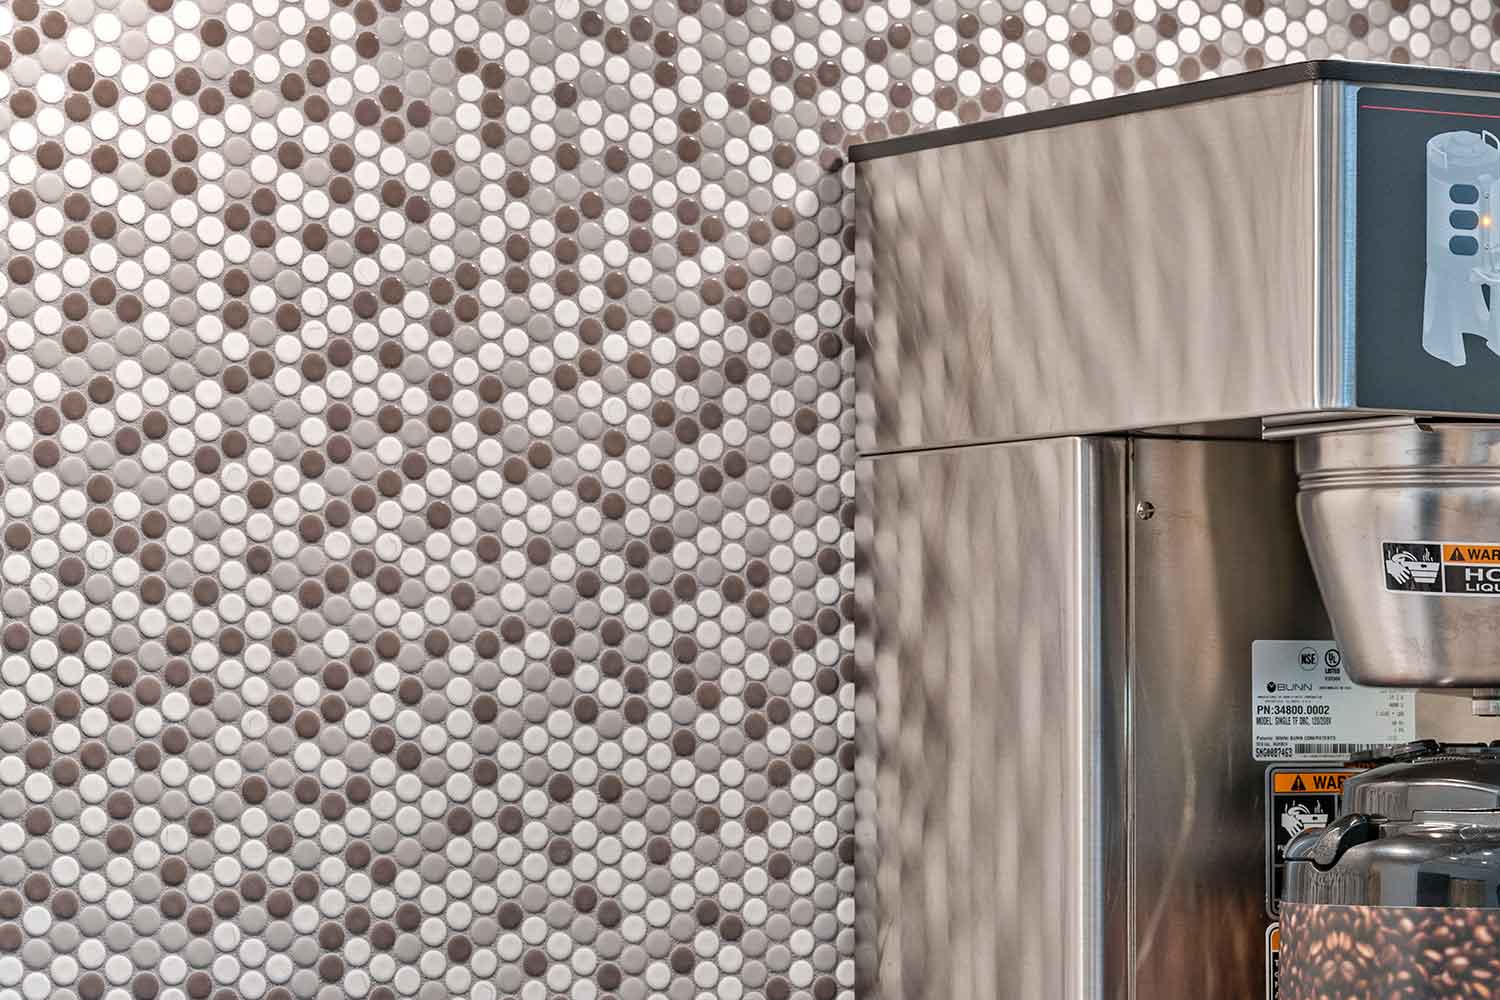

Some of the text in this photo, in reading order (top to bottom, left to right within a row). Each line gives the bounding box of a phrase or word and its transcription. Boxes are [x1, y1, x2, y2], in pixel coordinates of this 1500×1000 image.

[1277, 683, 1312, 691] BUNN
[1257, 705, 1330, 715] PN:34800.0002
[1275, 717, 1291, 726] SINGLE
